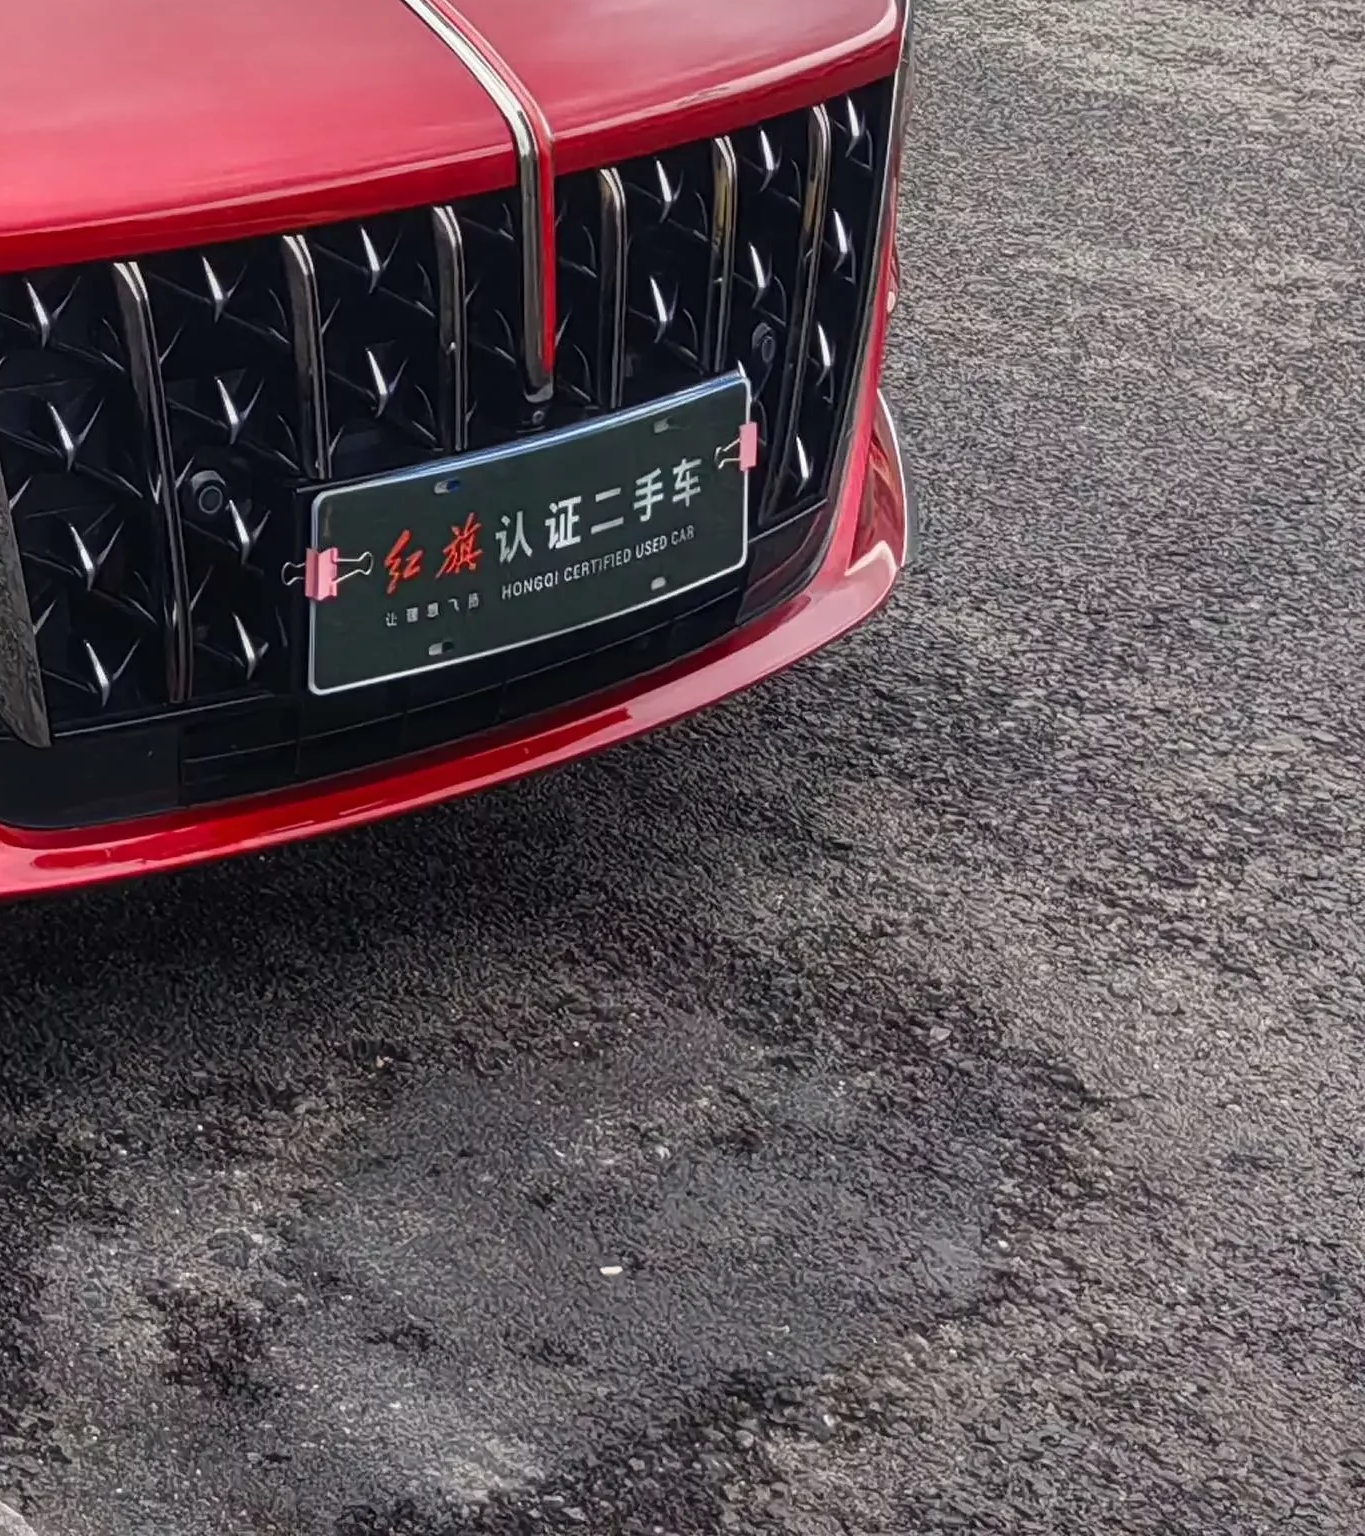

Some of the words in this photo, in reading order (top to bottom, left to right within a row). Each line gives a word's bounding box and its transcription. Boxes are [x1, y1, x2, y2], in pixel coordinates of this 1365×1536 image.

[501, 571, 559, 600] HONGQI
[563, 548, 632, 582] CERTIFIED
[635, 534, 668, 560] USED
[670, 524, 695, 546] CAR
